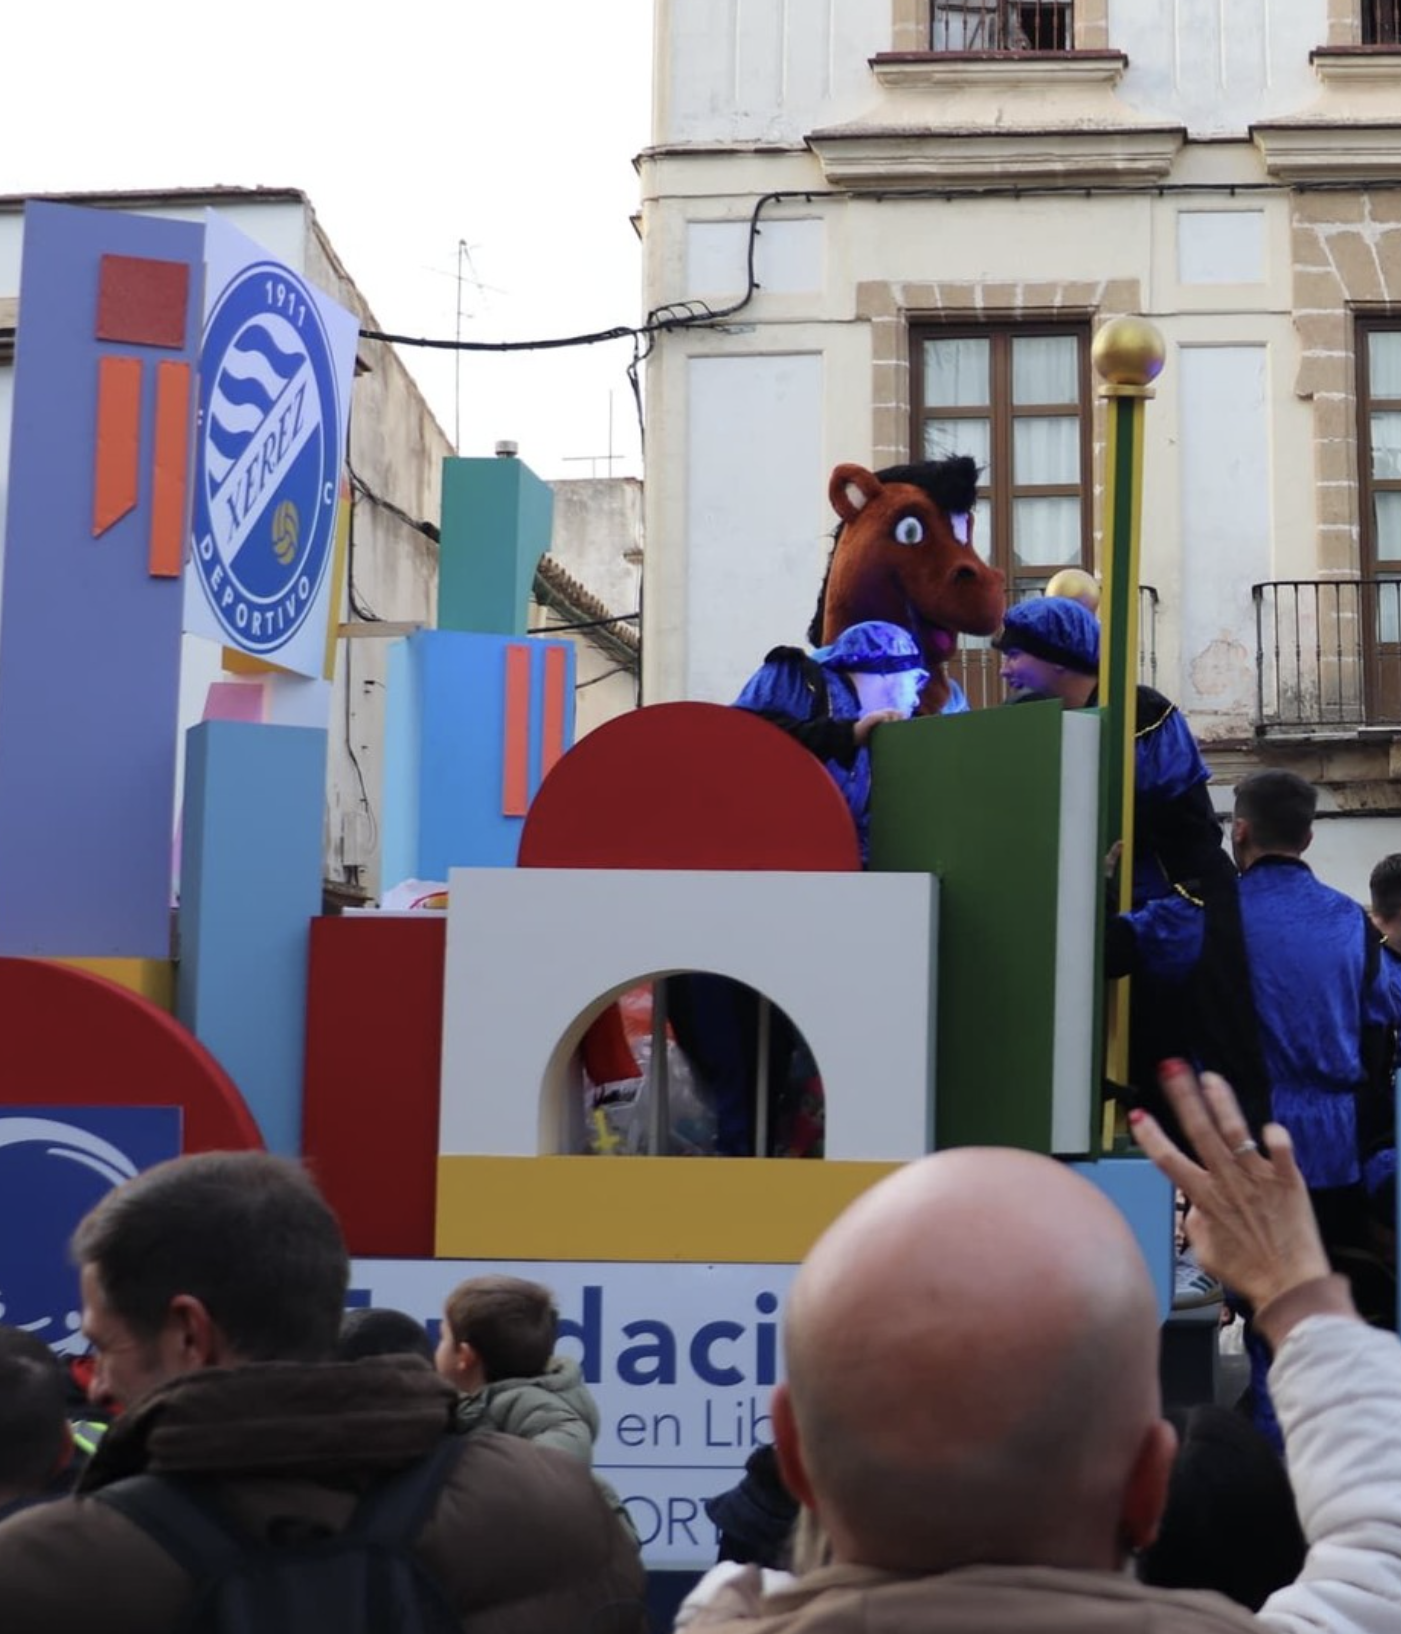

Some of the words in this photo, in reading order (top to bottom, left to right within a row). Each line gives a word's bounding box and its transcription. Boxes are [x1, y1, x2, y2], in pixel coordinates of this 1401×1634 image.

[265, 280, 306, 327] 1911
[226, 380, 306, 545] XEREZ
[323, 481, 333, 505] C
[200, 533, 310, 636] DEPORTIVO
[617, 1413, 681, 1447] en
